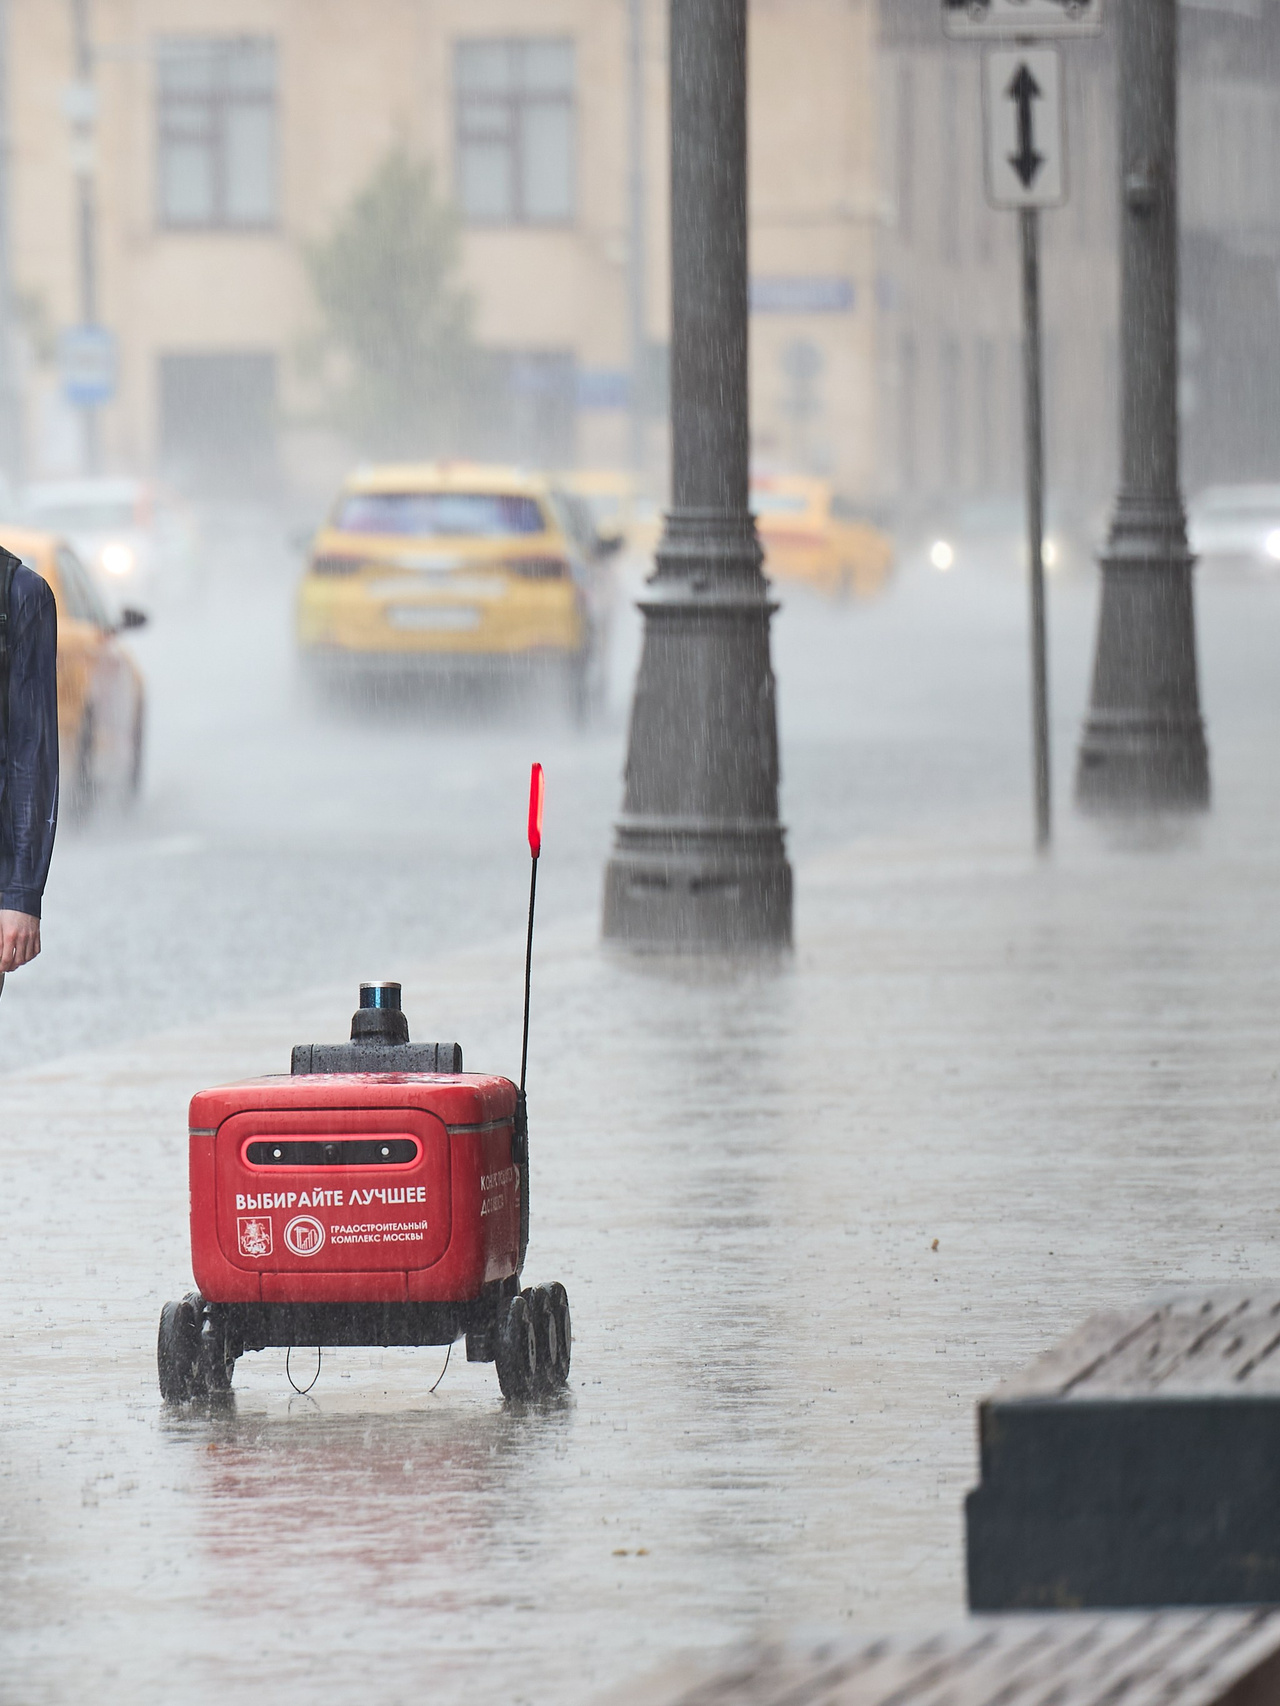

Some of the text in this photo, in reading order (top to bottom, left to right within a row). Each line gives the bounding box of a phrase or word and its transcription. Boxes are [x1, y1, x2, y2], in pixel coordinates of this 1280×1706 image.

[235, 1186, 426, 1210] ВЫБИРАЙТЕ ЛУЧШЕЕ
[330, 1220, 428, 1234] ГРАДОСТРОИТЕЛЬНЫЙ
[331, 1232, 424, 1244] КОМПЛЕКС МОСКВЫ
